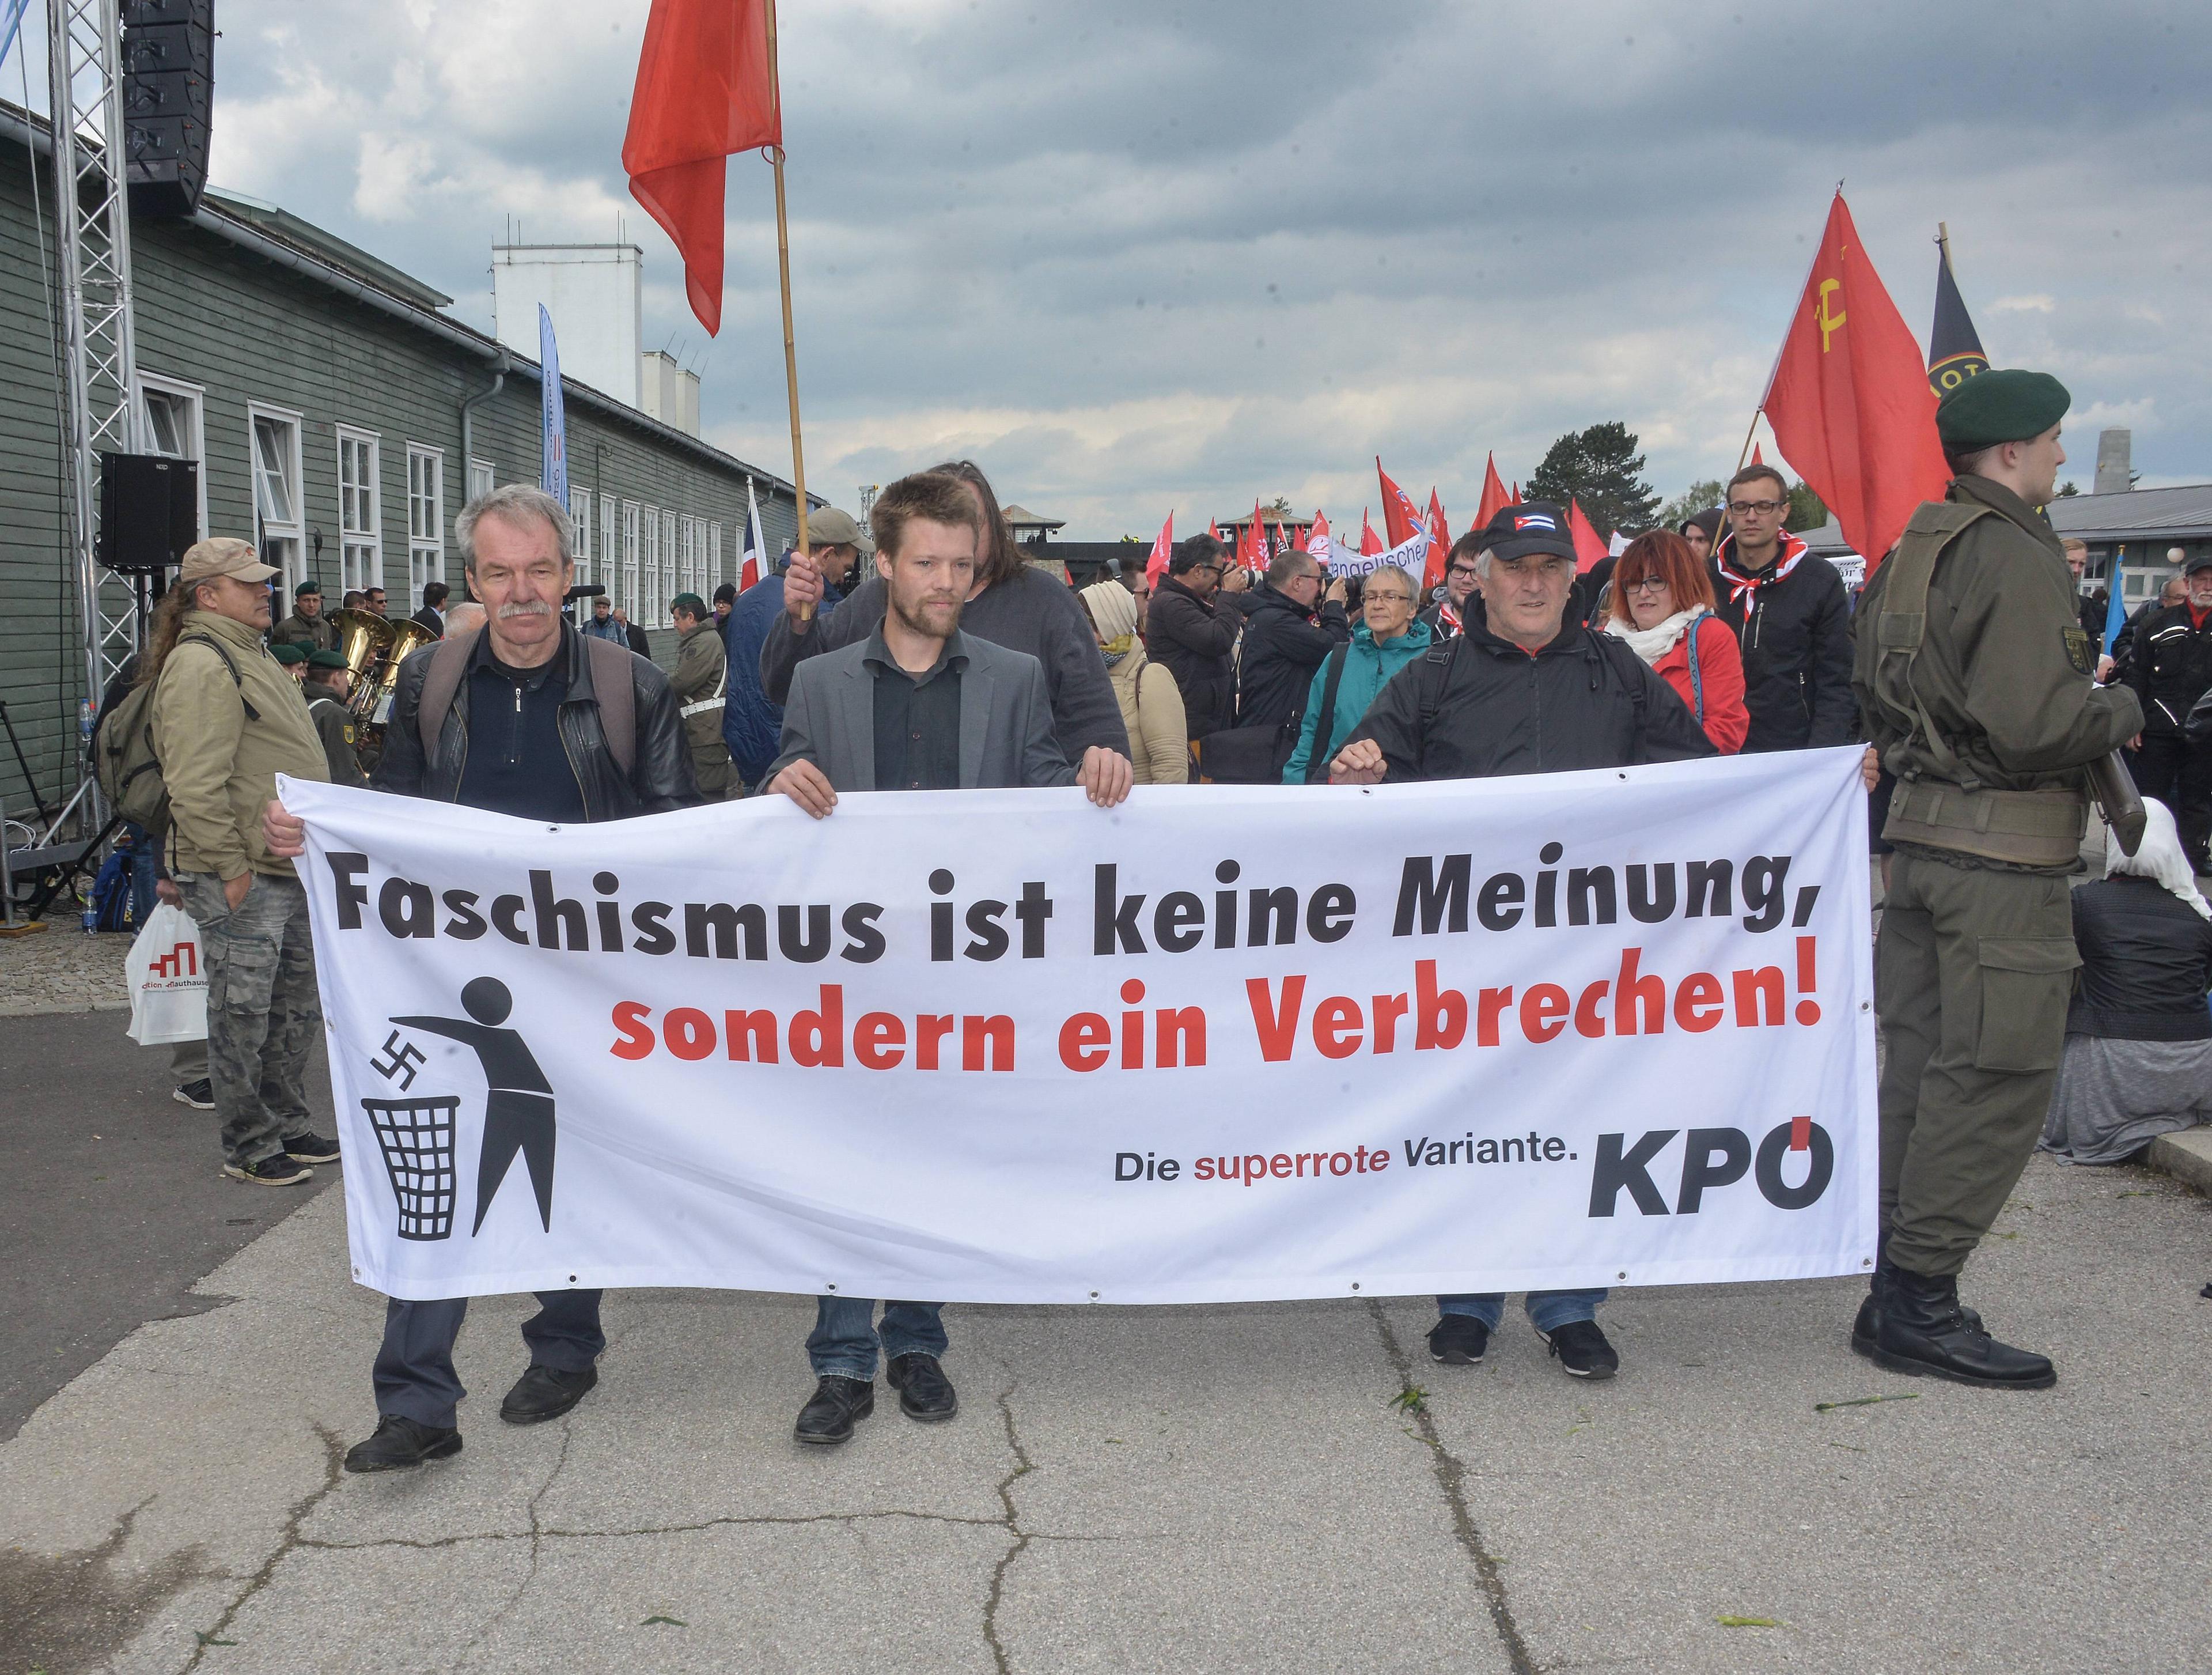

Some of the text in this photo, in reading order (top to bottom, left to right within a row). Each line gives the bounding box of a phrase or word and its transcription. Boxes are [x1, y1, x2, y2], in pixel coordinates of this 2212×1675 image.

[1332, 543, 1421, 578] angelische
[324, 842, 1821, 964] Faschismus ist keine Meinung,
[610, 936, 1821, 1072] sondern ein Verbrechen!
[1115, 1131, 1577, 1186] Die superrote Variante.
[1588, 1117, 1834, 1218] KPÖ
